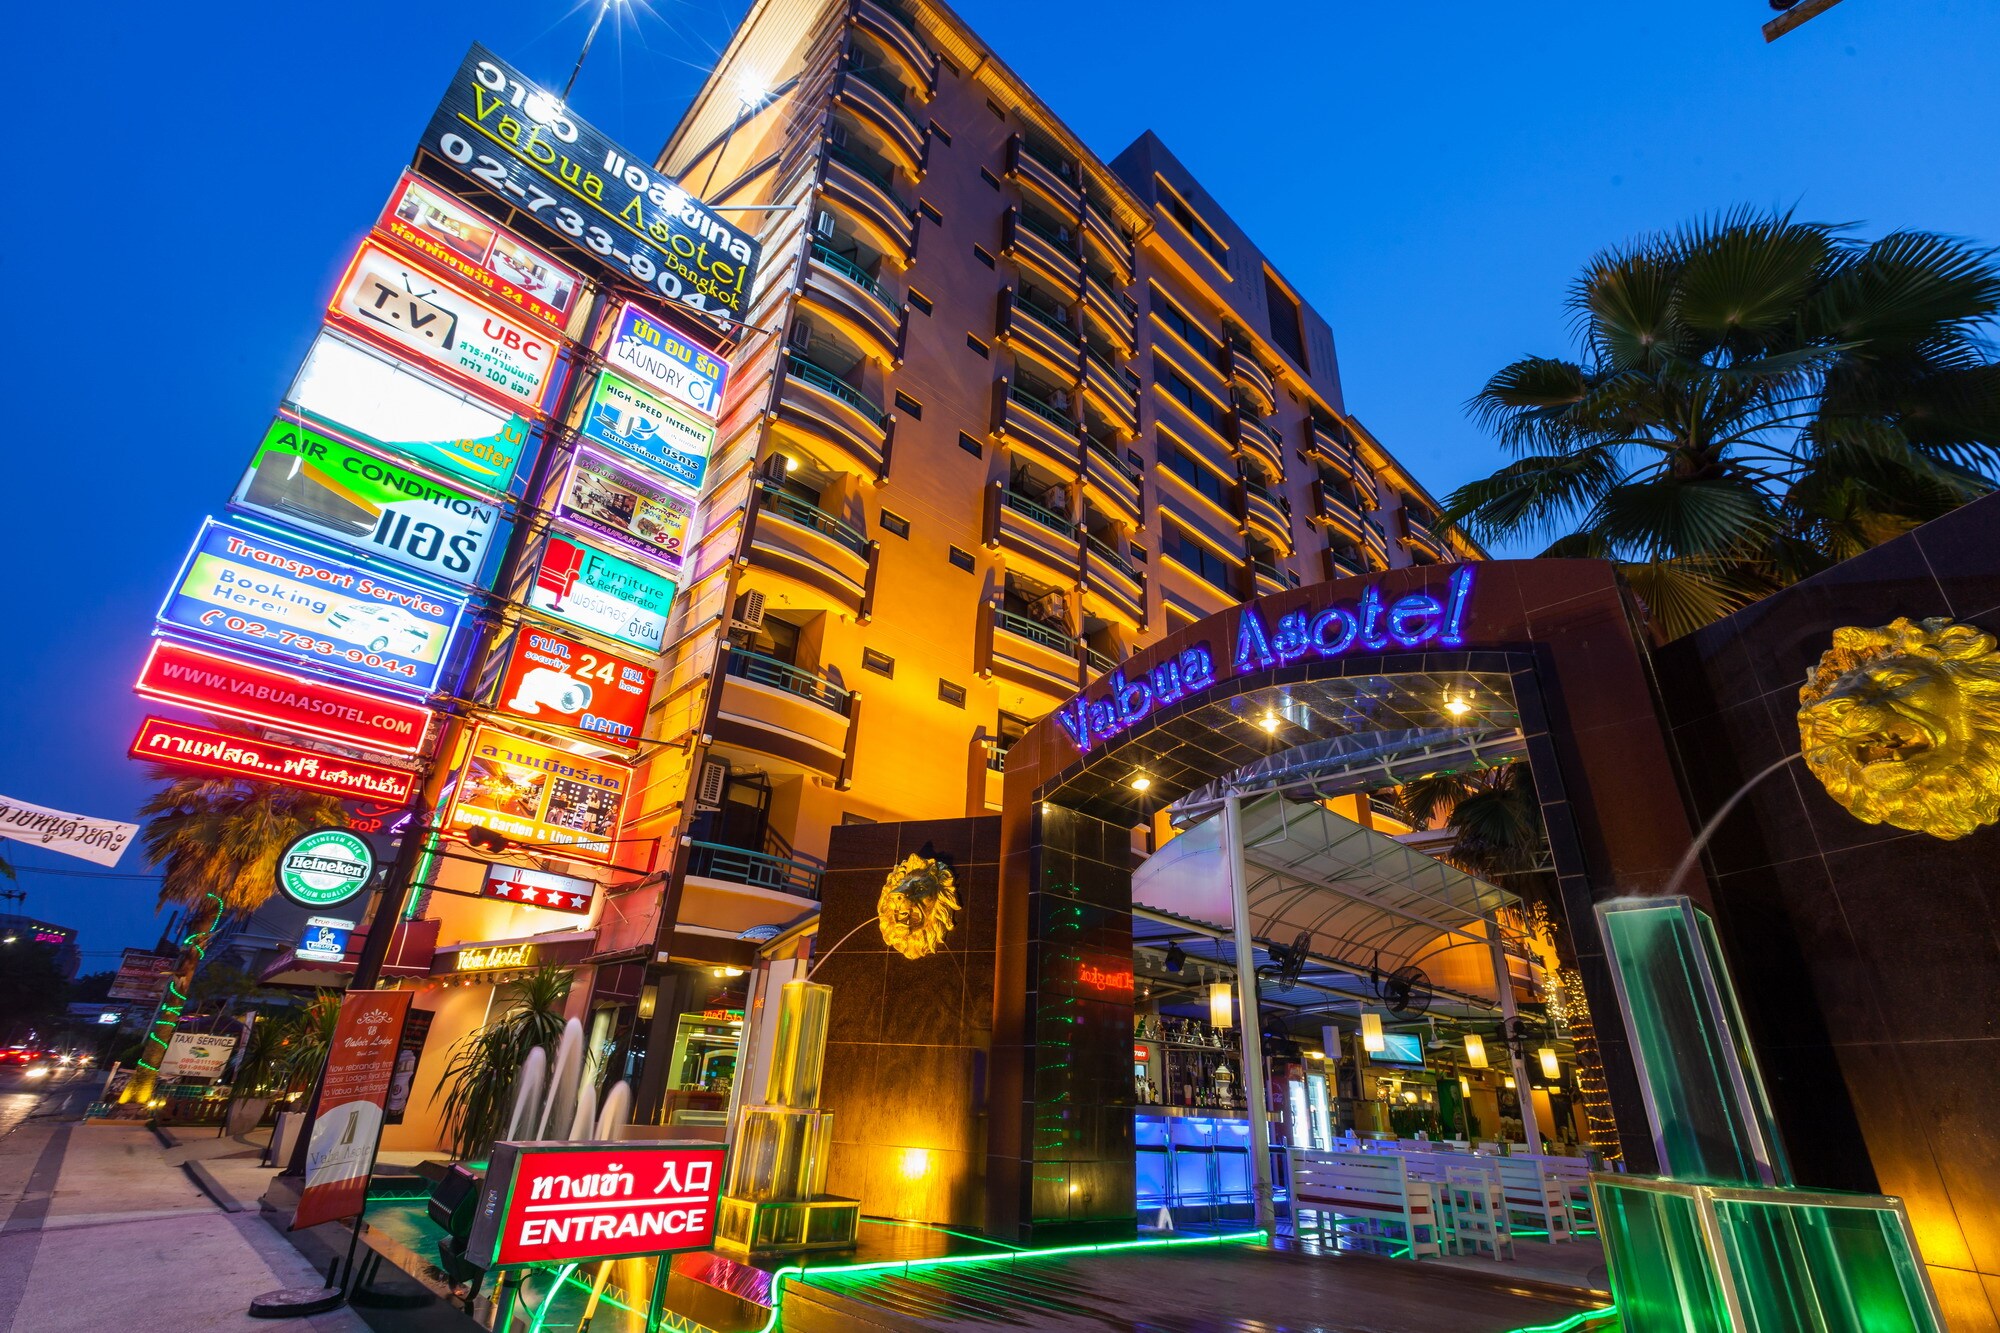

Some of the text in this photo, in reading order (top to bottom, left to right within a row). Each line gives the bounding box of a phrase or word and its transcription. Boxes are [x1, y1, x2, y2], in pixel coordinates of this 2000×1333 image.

[471, 82, 746, 293] Vabua Asotel
[440, 132, 732, 332] 02-733-9044
[390, 222, 494, 288] ห้องพักรายวัน
[501, 286, 523, 305] 24
[665, 252, 739, 312] Bangkok
[374, 282, 437, 338] T.V.
[482, 318, 542, 361] UBC
[665, 339, 692, 363] อบ
[459, 355, 530, 397] กว่า 100 ช่อง
[618, 342, 684, 389] LAUNDRY
[607, 384, 707, 442] HIGH SPEED INTERNET
[276, 432, 492, 524] AIR CONDITION
[662, 445, 699, 470] บริการ
[652, 492, 667, 505] 24
[373, 508, 483, 573] แอร์
[570, 512, 644, 546] RESTAURANT
[219, 569, 328, 614] Booking
[227, 537, 444, 617] Transport Service
[585, 575, 658, 611] & Refrigerator
[587, 554, 664, 600] Furniture
[226, 615, 418, 678] 02-733-9044
[628, 617, 659, 642] ตู้เย็น
[524, 650, 571, 673] security
[576, 653, 615, 686] 24
[1057, 563, 1475, 752] Vabua Asotel
[162, 662, 413, 735] WWW.VABUAASOTEL.COM
[618, 680, 643, 696] hour
[580, 713, 633, 743] CCTV
[481, 744, 620, 789] ลานเบียร์สด
[306, 835, 363, 854] HEINEKEN BEER
[453, 808, 609, 854] Beer Garden & Live Music
[289, 877, 318, 898] PREMIUM
[320, 883, 351, 898] QUALITY
[290, 856, 363, 877] Heineken
[175, 1034, 234, 1047] TAXI SERVICE
[346, 1074, 367, 1083] Lodge
[530, 1163, 634, 1201] ทางเข้า
[653, 1161, 713, 1194] 入口
[519, 1208, 707, 1247] ENTRANCE
